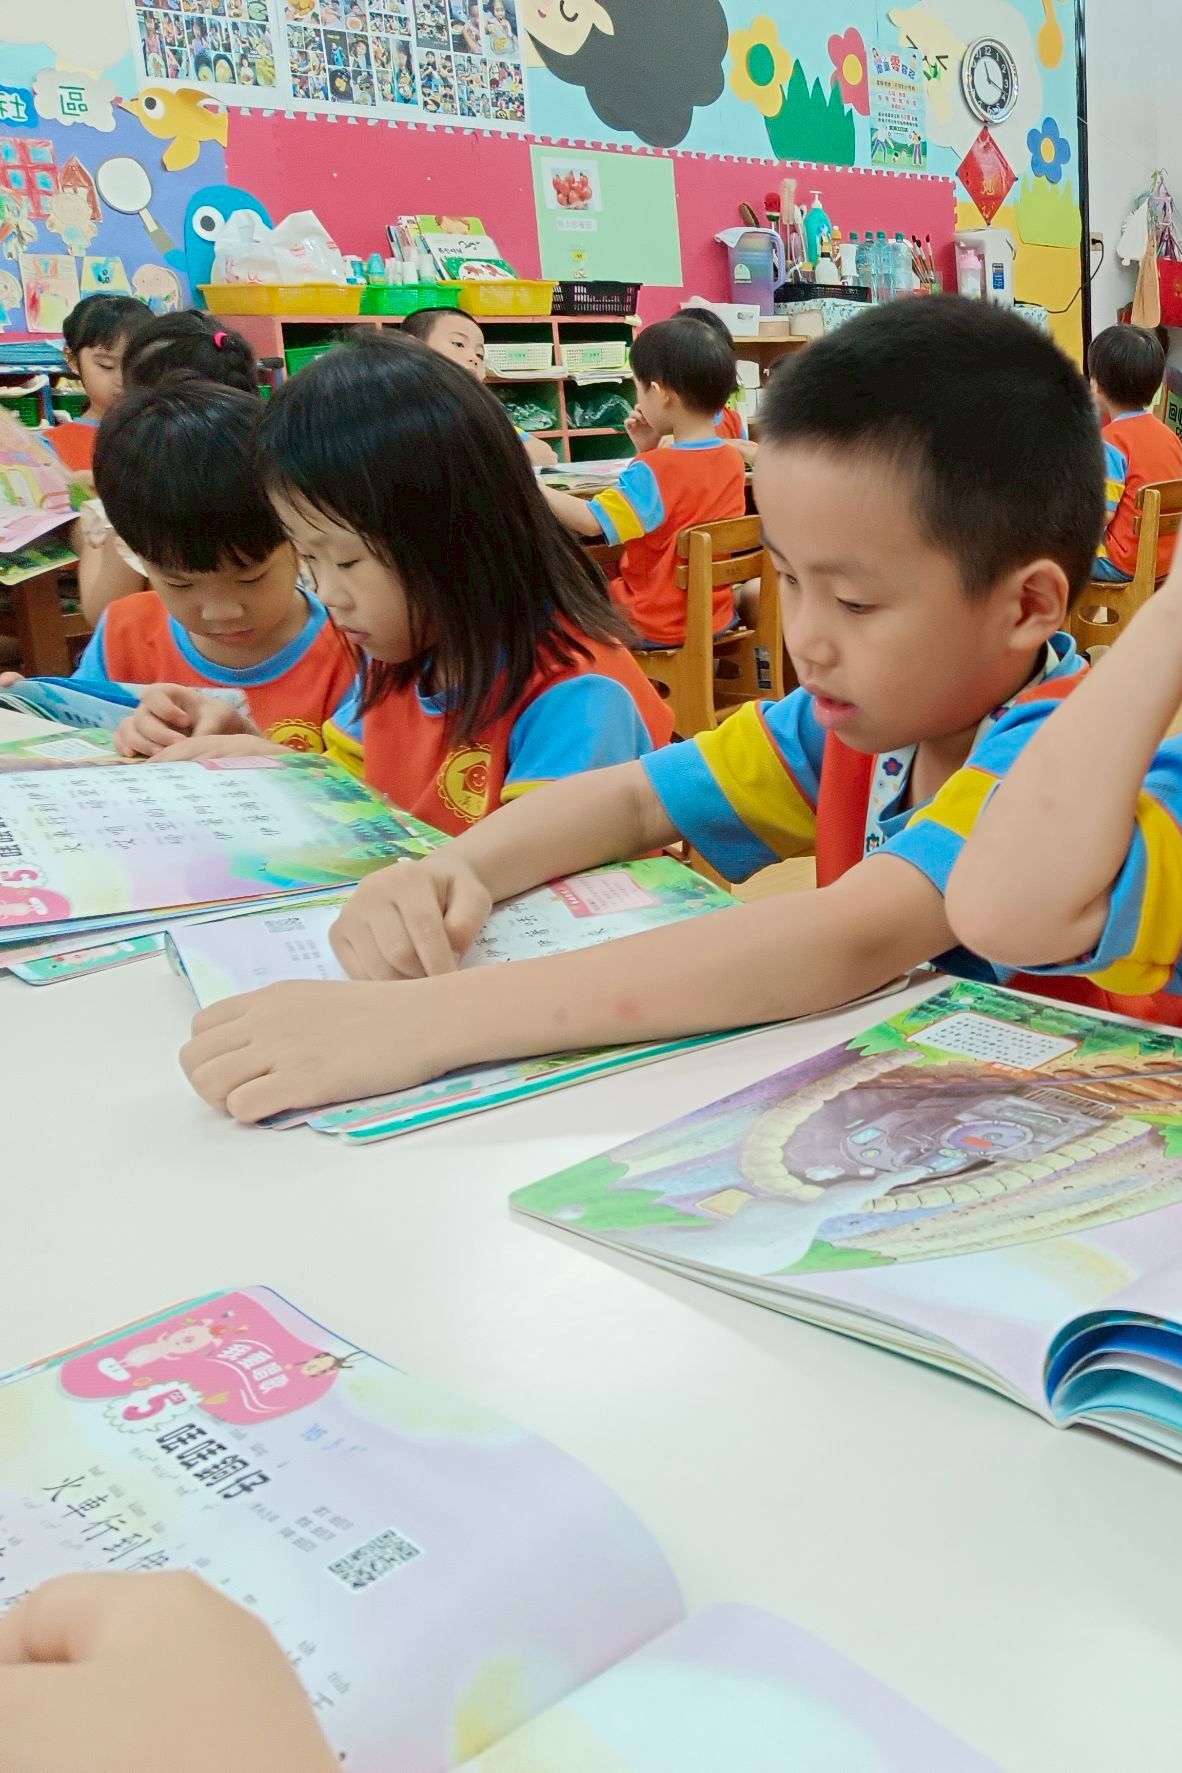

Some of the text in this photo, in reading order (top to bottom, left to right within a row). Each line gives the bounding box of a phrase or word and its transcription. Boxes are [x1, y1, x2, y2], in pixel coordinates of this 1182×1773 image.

[58, 85, 88, 117] 區
[2, 868, 39, 882] 5
[216, 1341, 289, 1395] 我愛唱歌
[122, 1388, 188, 1422] 5
